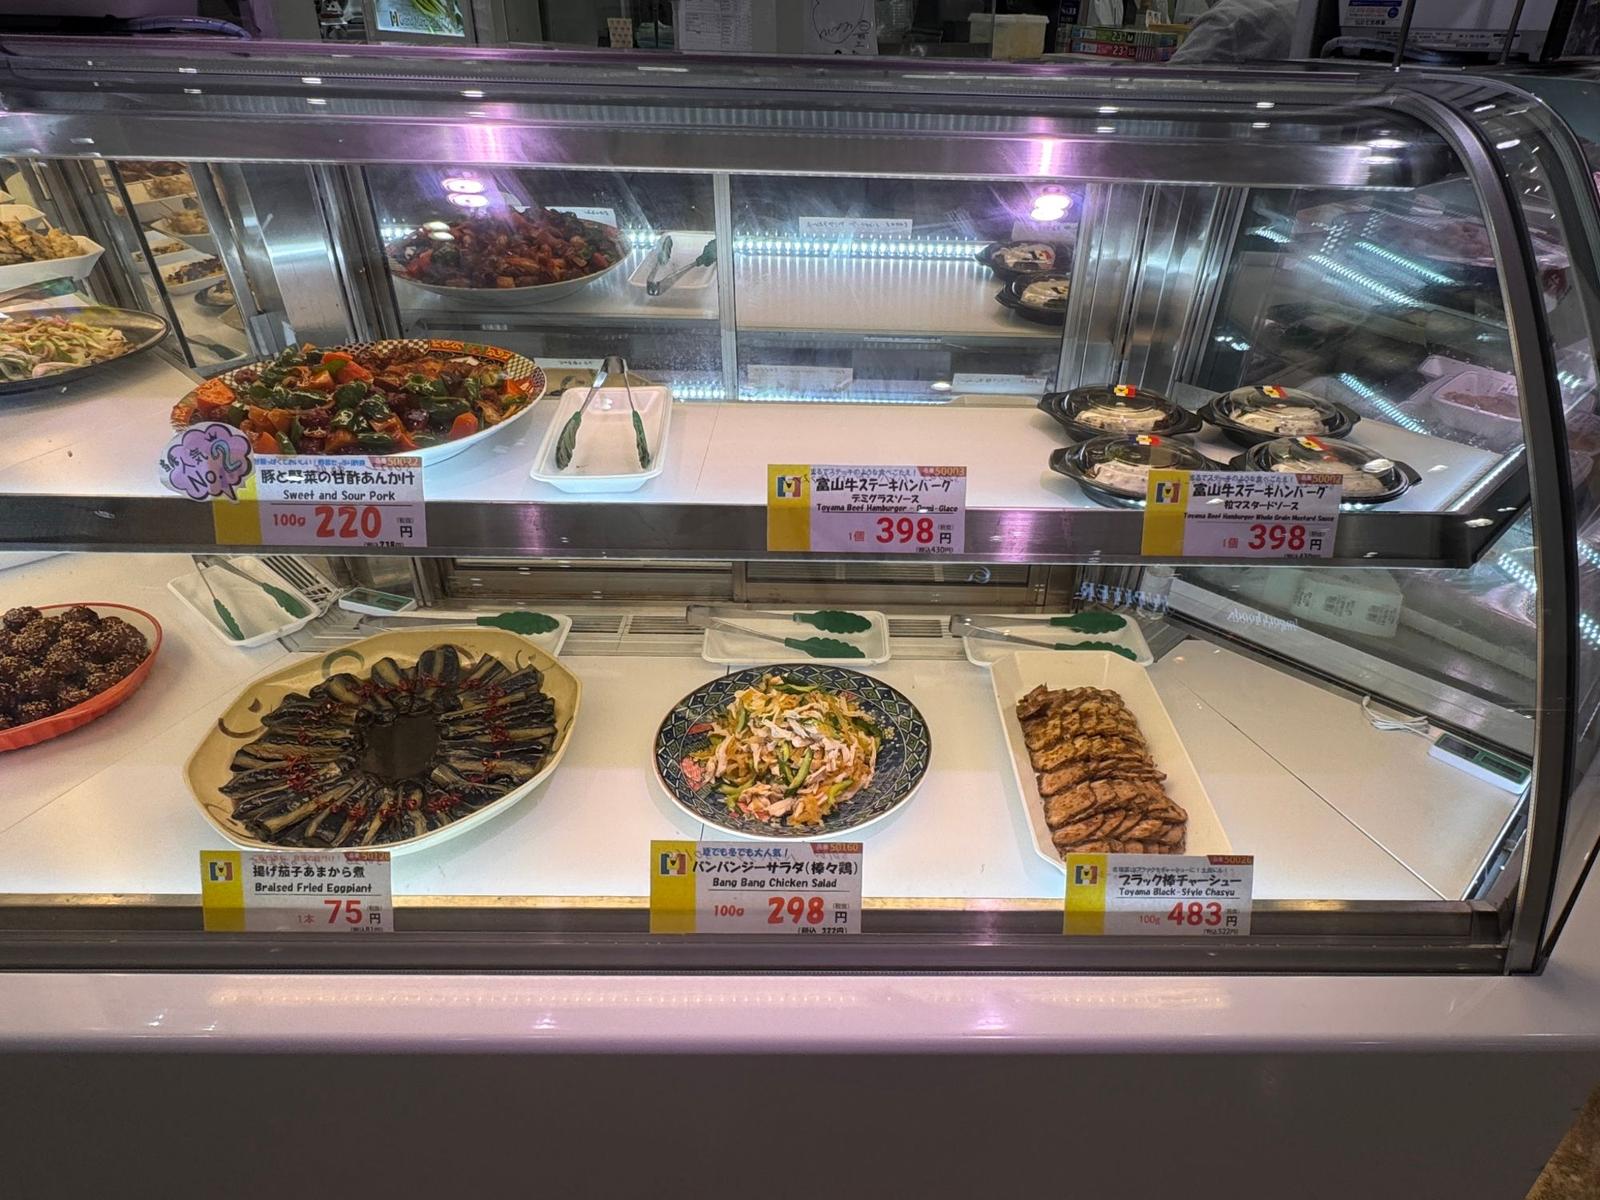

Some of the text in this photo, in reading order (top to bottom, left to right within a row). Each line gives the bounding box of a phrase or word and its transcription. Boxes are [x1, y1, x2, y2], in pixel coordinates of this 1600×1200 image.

[261, 469, 415, 485] 豚と野菜の甘酢あんかけ
[816, 478, 952, 493] 富山牛ステーキハンバーグ
[1193, 483, 1327, 498] 富山牛ステーキハンバーグ
[283, 490, 396, 501] Sweet and Sour Pork
[851, 494, 919, 503] デミグラスソース
[817, 504, 845, 512] Toyama
[847, 504, 865, 512] Beef
[866, 504, 907, 513] Hamburger
[1224, 500, 1299, 511] 粒マスタードソース
[314, 506, 382, 538] 220
[1222, 513, 1254, 521] Hamburger
[399, 525, 413, 538] 円
[876, 517, 934, 544] 398
[939, 532, 952, 544] 円
[1248, 523, 1306, 551] 398
[253, 866, 365, 878] 揚げ茄子あまから煮
[713, 878, 837, 888] Bang Bang Chicken Salad
[1118, 874, 1242, 886] ブラック棒チャーシュー
[255, 882, 372, 894] Braised Fried Eggplant
[1119, 887, 1151, 897] Toyama
[1205, 887, 1236, 897] Chasyu
[324, 899, 363, 924] 75
[767, 896, 825, 924] 298
[1167, 902, 1223, 926] 483
[369, 912, 381, 924] 円
[834, 911, 848, 923] 円
[1226, 915, 1238, 927] 円
